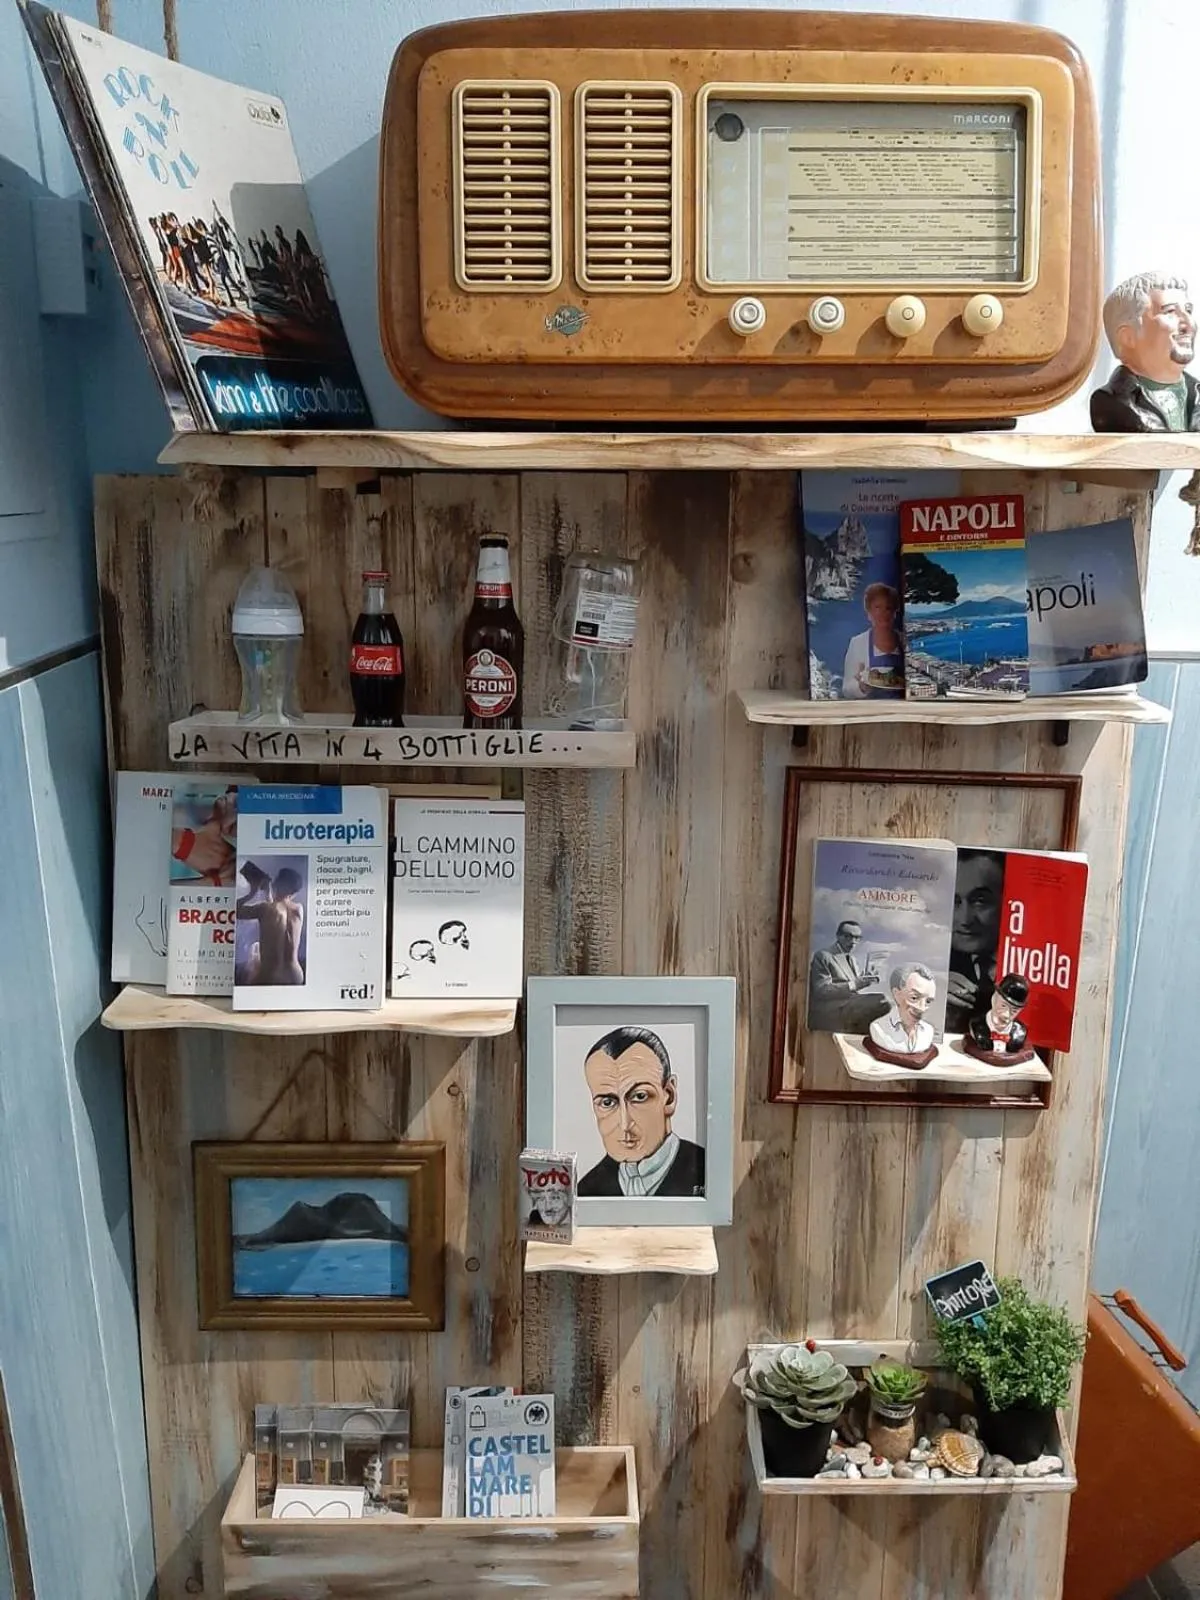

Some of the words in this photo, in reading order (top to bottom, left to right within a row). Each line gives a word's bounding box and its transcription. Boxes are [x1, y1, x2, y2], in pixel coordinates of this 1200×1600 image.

[953, 115, 1010, 124] MARCONI
[251, 392, 264, 413] &
[912, 502, 1016, 532] NAPOLI
[356, 656, 393, 671] Coca-Cola
[466, 678, 512, 693] PERONI
[174, 733, 208, 759] LA
[363, 738, 383, 761] 4
[264, 818, 375, 844] Idroterapia
[417, 836, 516, 854] CAMMINO
[317, 855, 371, 864] Spugnature,
[347, 865, 373, 874] bagni,
[393, 860, 515, 878] DELL'UOMO
[316, 876, 357, 885] impacchi
[316, 888, 331, 896] per
[333, 888, 375, 896] prevenire
[860, 889, 917, 903] AMMORE
[180, 896, 230, 904] ALBERT
[321, 908, 355, 917] disturbi
[316, 919, 350, 928] comuni
[1003, 936, 1071, 989] livella
[340, 984, 374, 999] red!
[468, 1434, 551, 1457] CASTEL
[469, 1456, 516, 1477] LAM
[469, 1474, 532, 1497] MARE
[469, 1496, 492, 1517] DI
